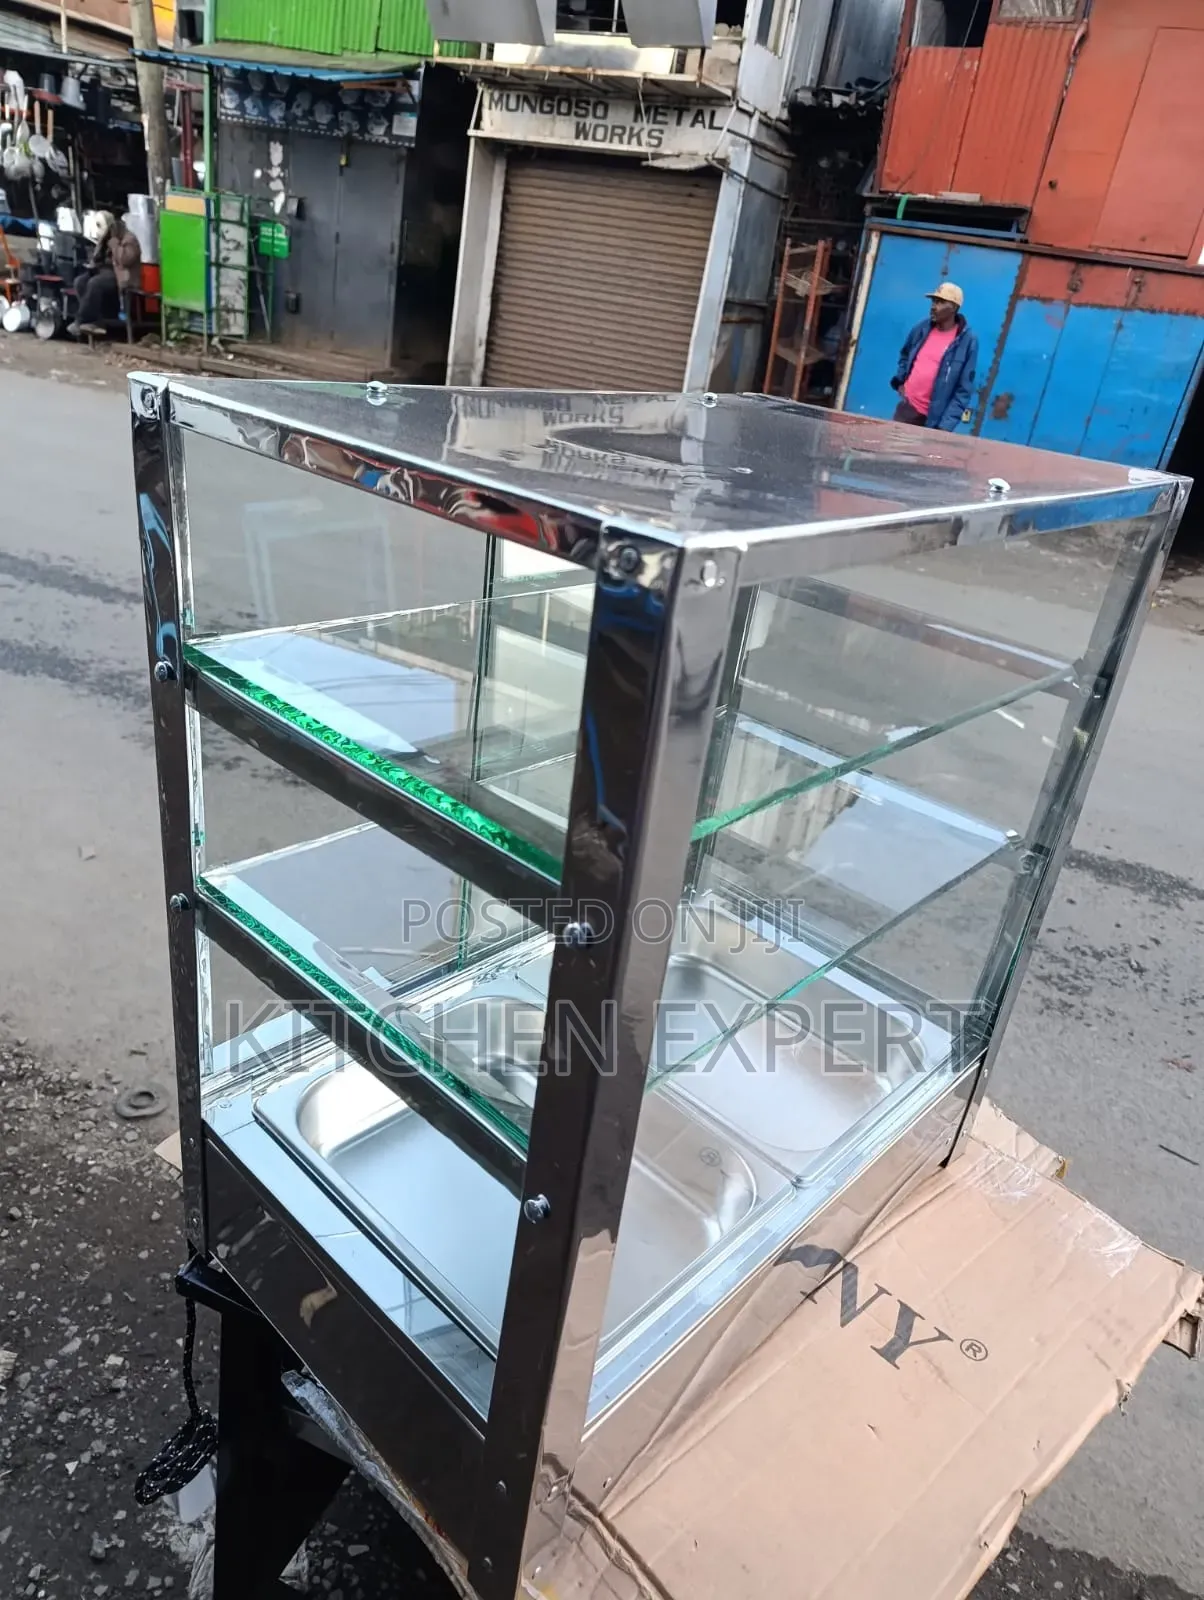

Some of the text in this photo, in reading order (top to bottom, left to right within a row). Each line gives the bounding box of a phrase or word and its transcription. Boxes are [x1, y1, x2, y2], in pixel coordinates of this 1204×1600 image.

[487, 92, 725, 131] MUNGOSO METAL
[573, 121, 665, 149] WORKS
